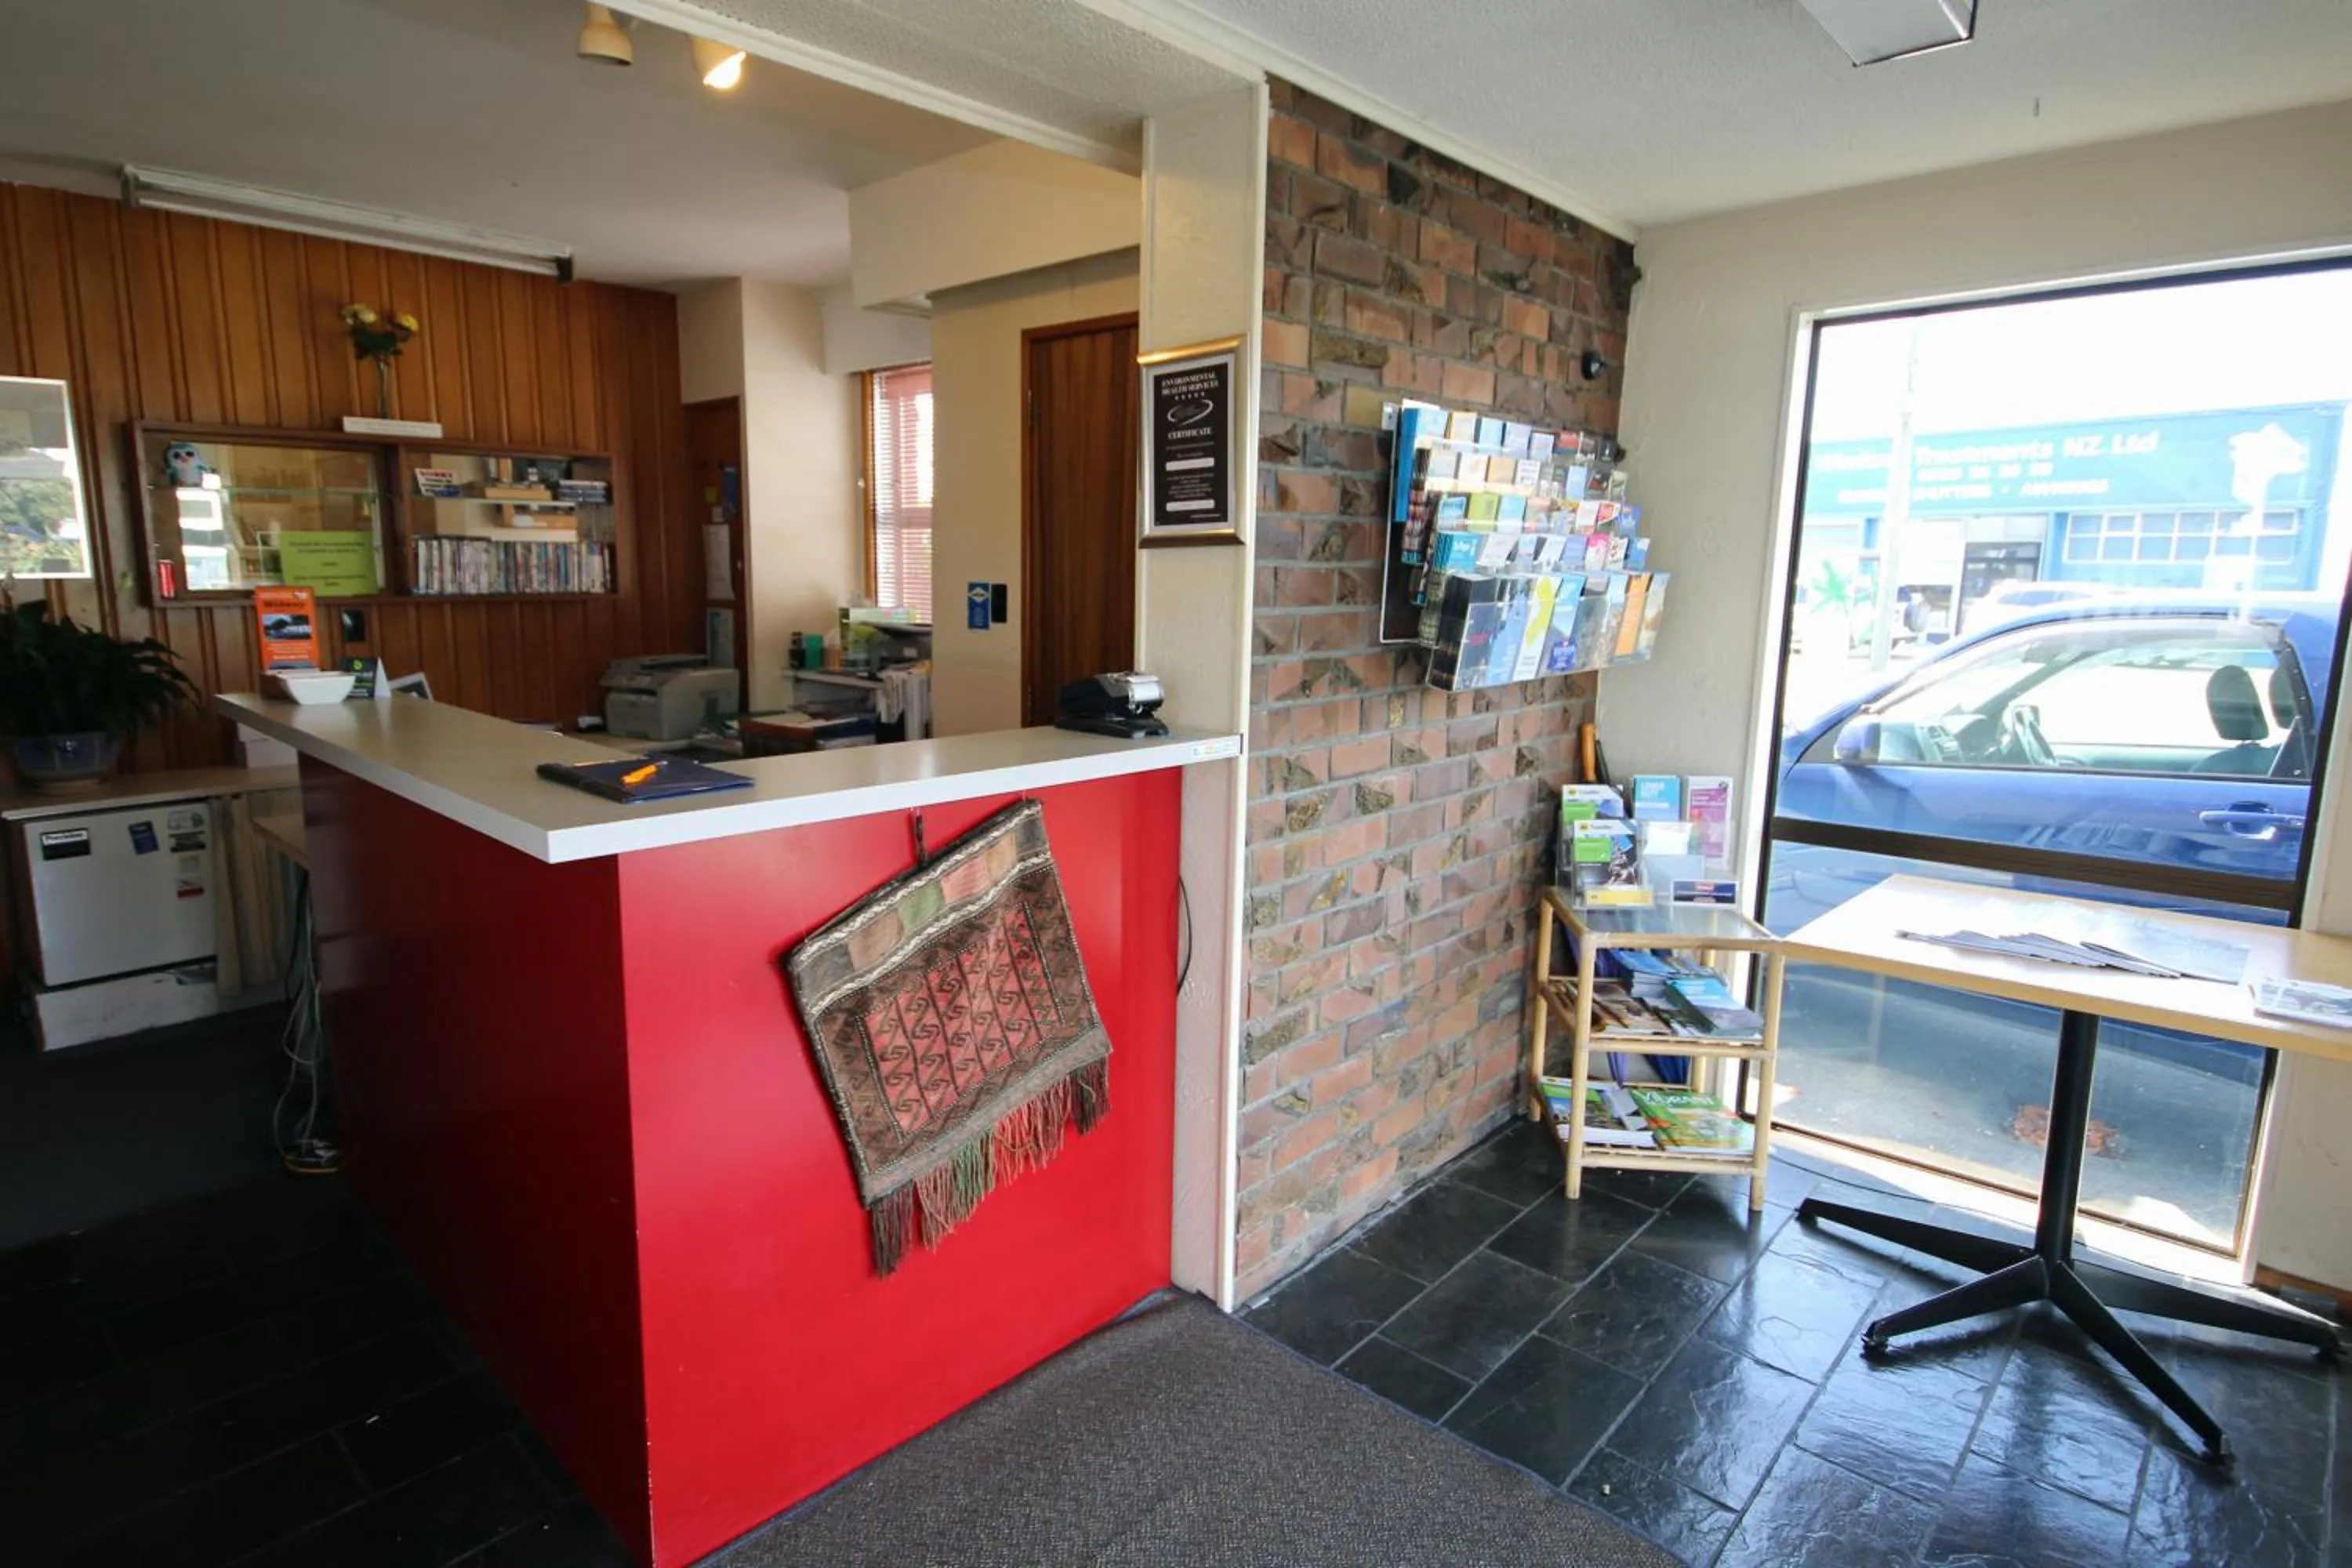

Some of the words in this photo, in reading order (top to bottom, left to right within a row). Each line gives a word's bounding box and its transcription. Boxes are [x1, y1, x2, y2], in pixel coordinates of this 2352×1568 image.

[1162, 371, 1217, 387] ENVIRONMENTAL
[1161, 383, 1188, 396] HEALTH
[1189, 379, 1220, 391] SERVICES
[1167, 426, 1212, 440] CERTIFICATE
[2063, 435, 2103, 456] NZ
[2112, 430, 2159, 453] Ltd
